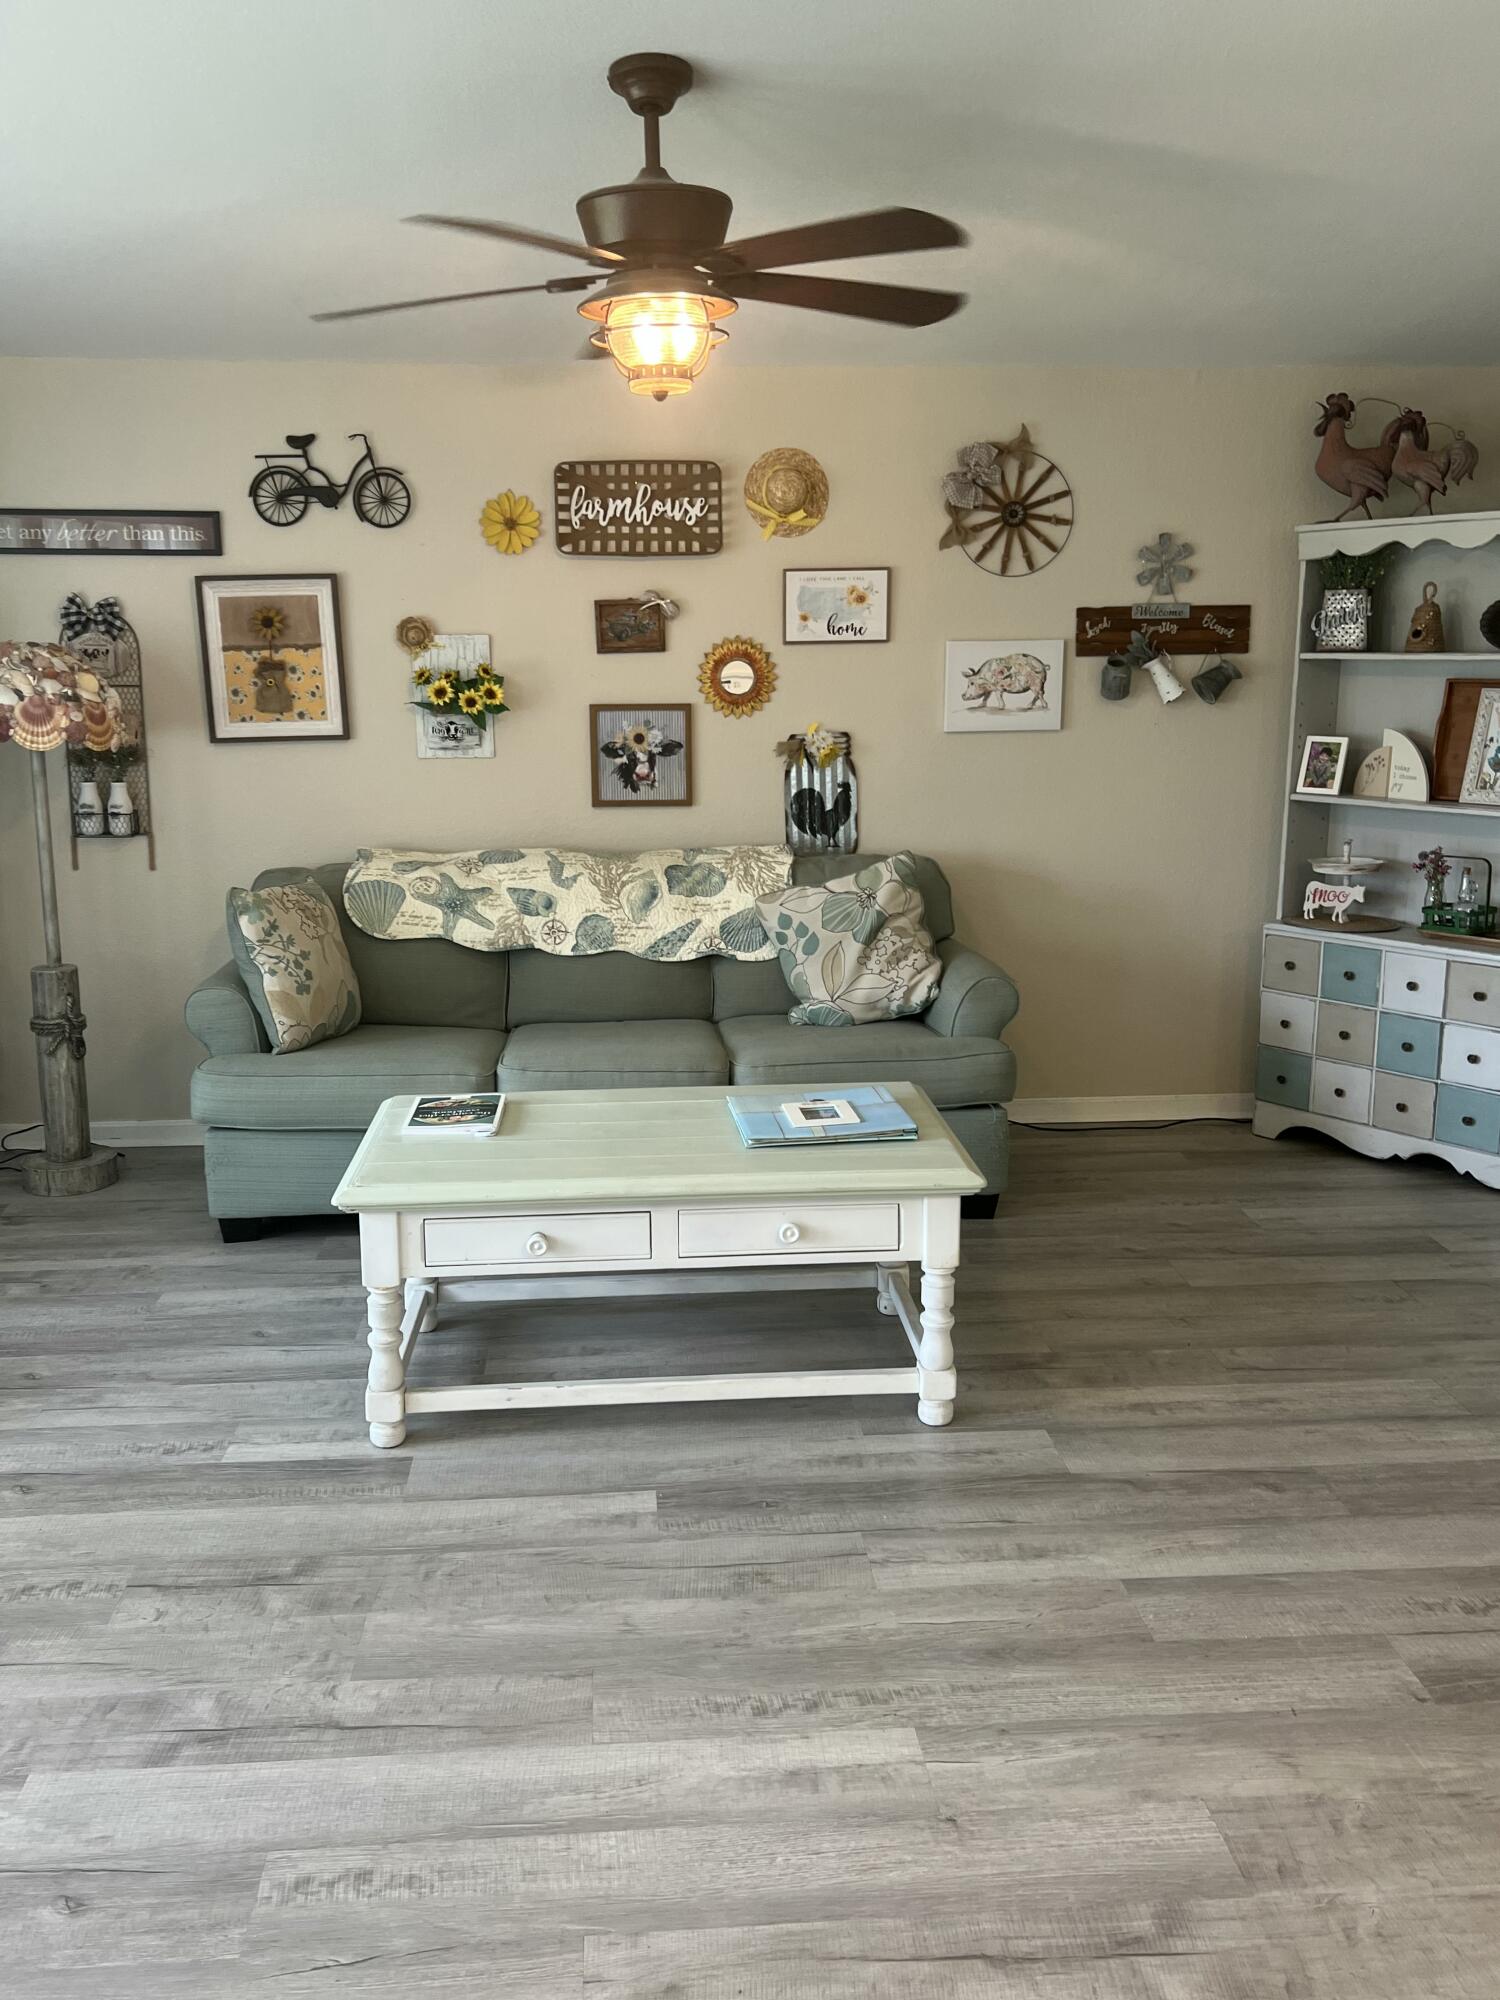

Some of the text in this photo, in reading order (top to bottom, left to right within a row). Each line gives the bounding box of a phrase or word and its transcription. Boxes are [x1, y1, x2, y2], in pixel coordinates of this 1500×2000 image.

[570, 484, 709, 530] farmhouse
[0, 526, 14, 540] et
[19, 528, 54, 545] any
[56, 518, 118, 549] better
[123, 524, 165, 541] than
[1135, 604, 1184, 617] Welcome
[826, 613, 868, 637] home
[1202, 612, 1236, 639] Blessed
